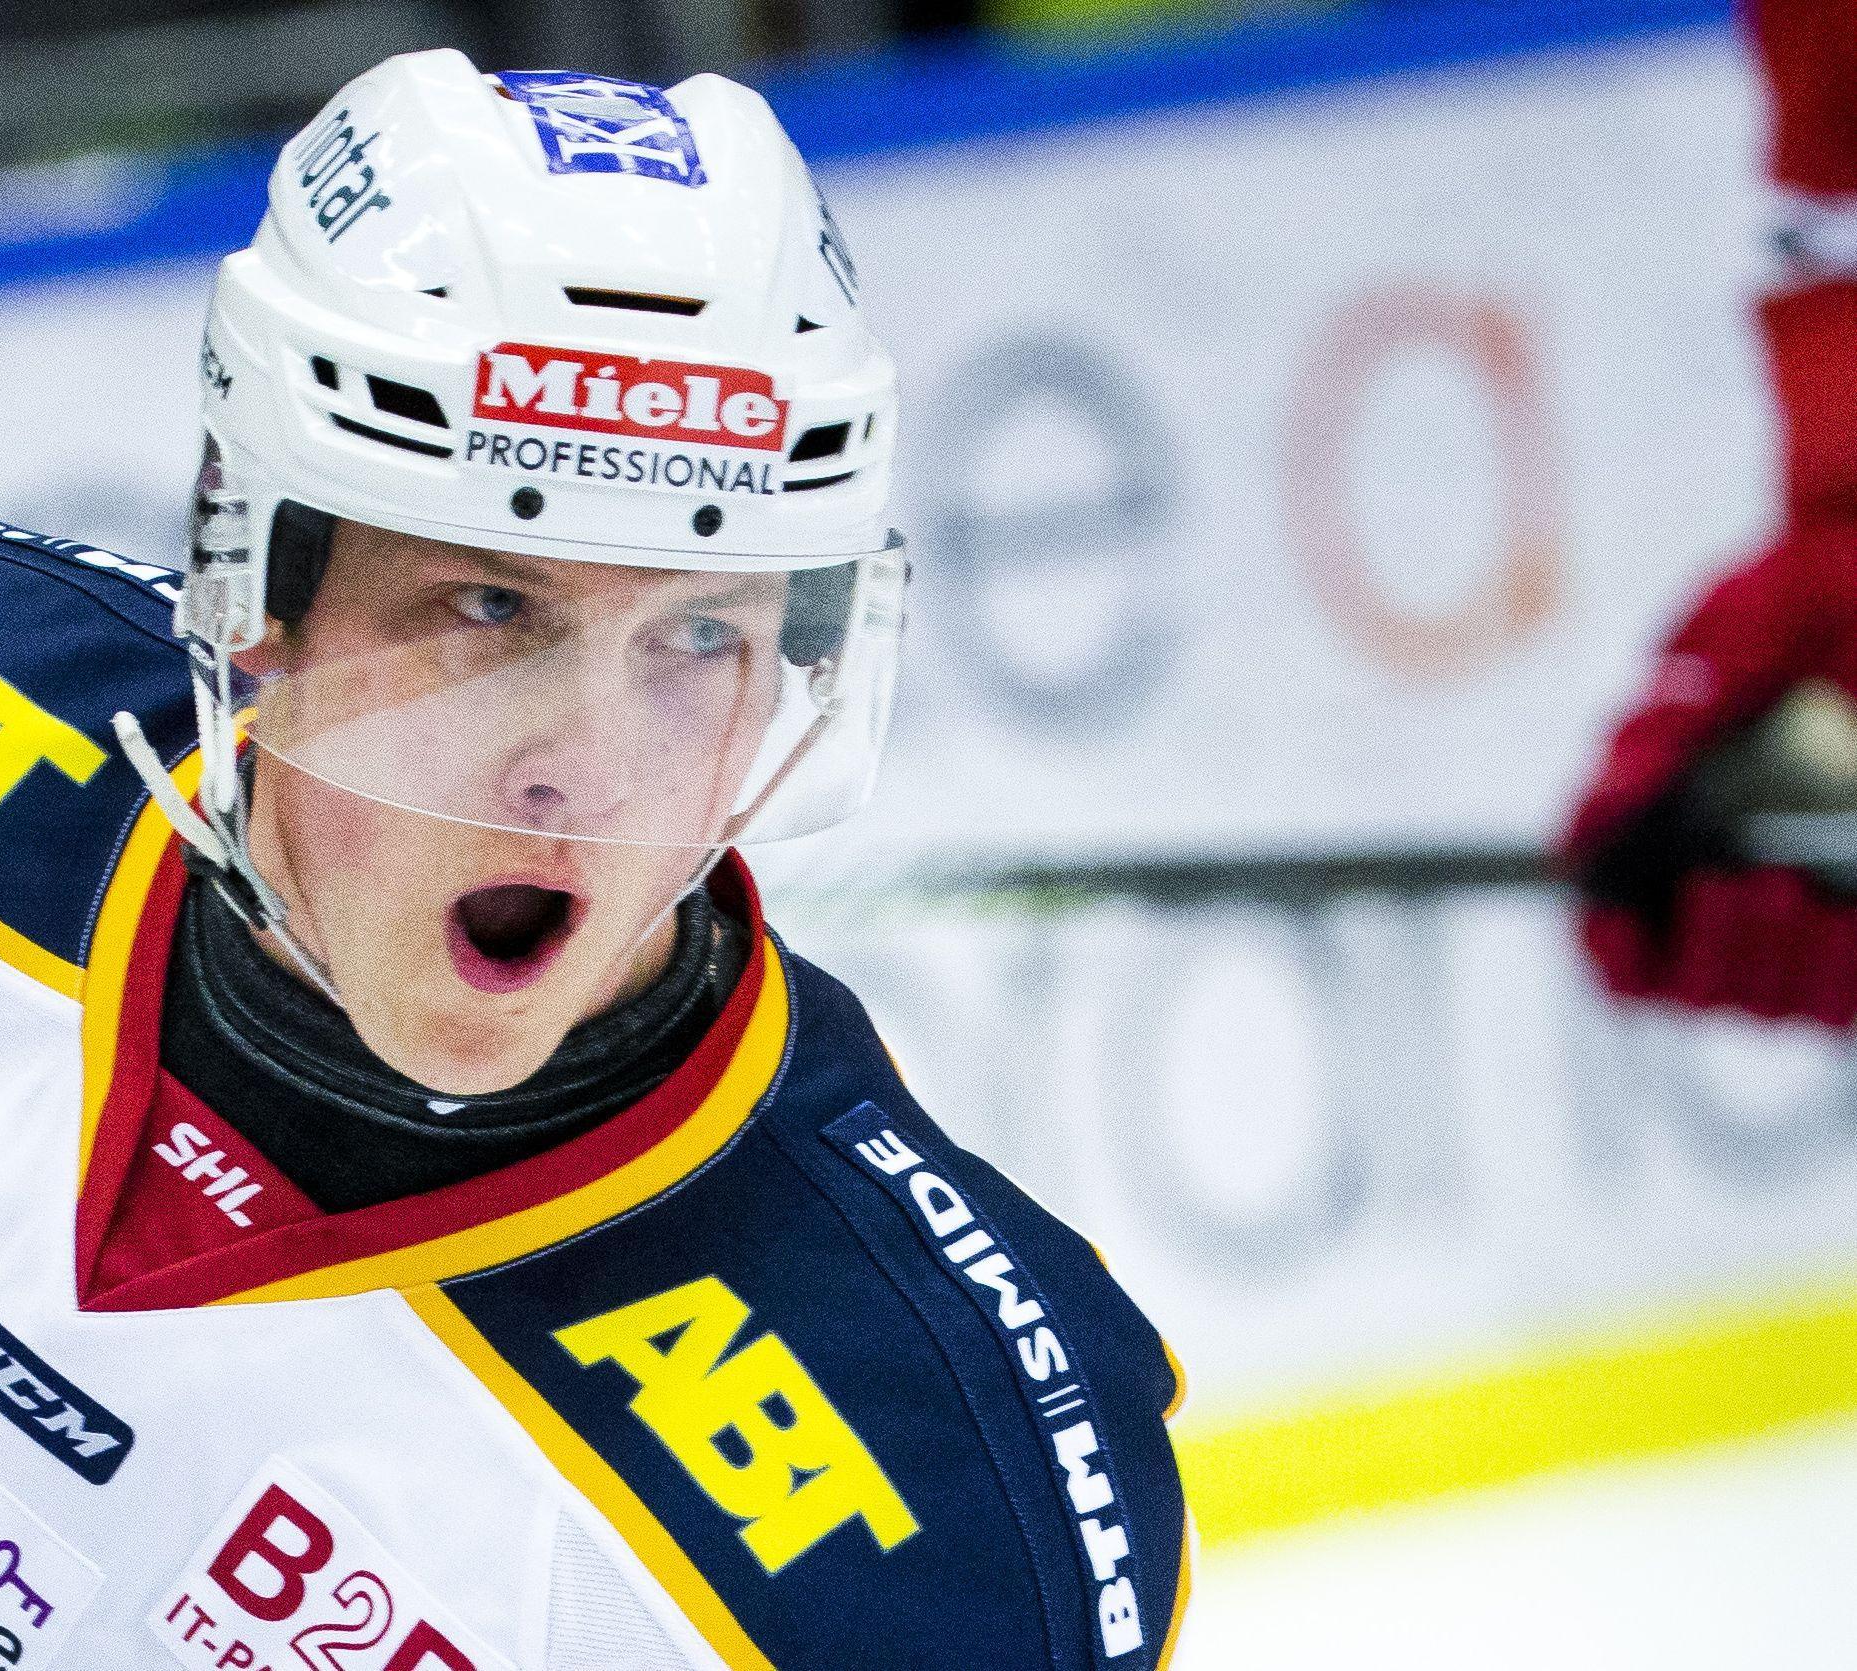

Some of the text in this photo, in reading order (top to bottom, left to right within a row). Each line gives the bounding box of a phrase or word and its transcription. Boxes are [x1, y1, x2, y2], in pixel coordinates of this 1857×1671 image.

[295, 109, 392, 244] notar
[481, 352, 779, 437] Miele
[465, 429, 777, 495] PROFESSIONAL
[151, 1121, 264, 1228] SHL
[550, 1274, 924, 1577] ABT
